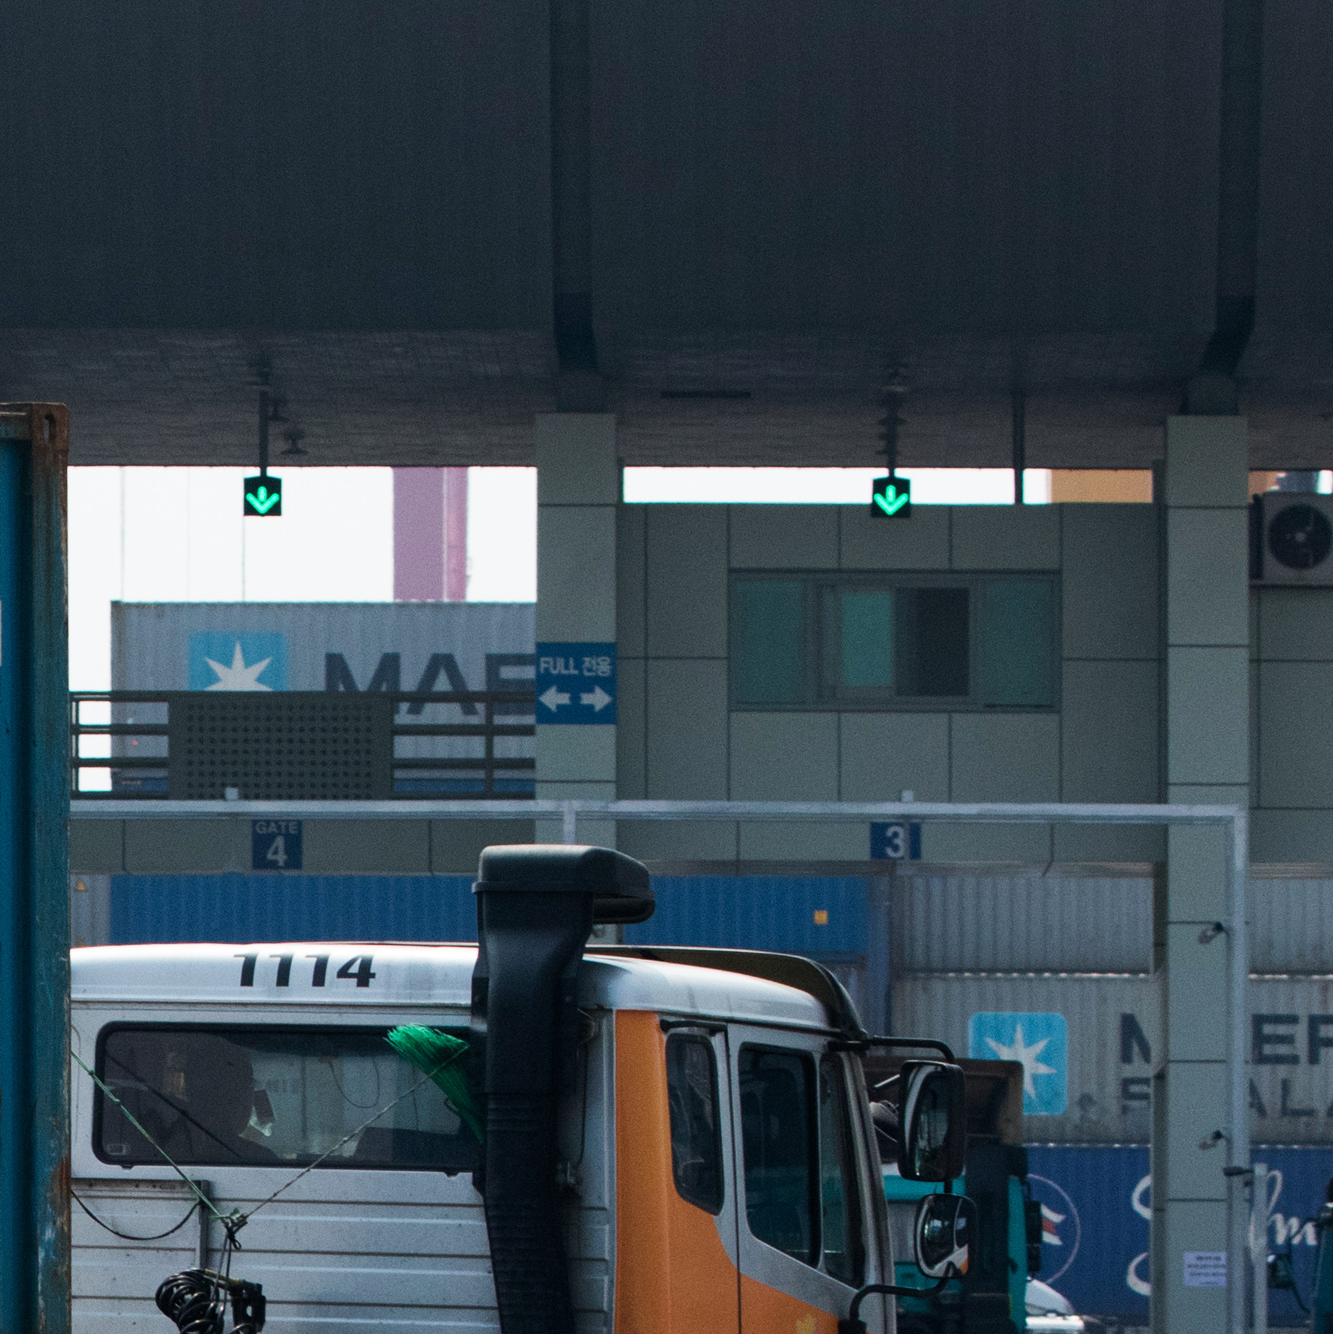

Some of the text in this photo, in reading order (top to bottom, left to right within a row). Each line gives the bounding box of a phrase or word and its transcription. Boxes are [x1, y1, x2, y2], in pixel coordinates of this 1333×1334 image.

[539, 656, 612, 677] FULL 전용
[255, 821, 298, 834] GATE
[885, 825, 905, 858] 3
[267, 835, 288, 867] 4
[233, 953, 376, 988] 1114
